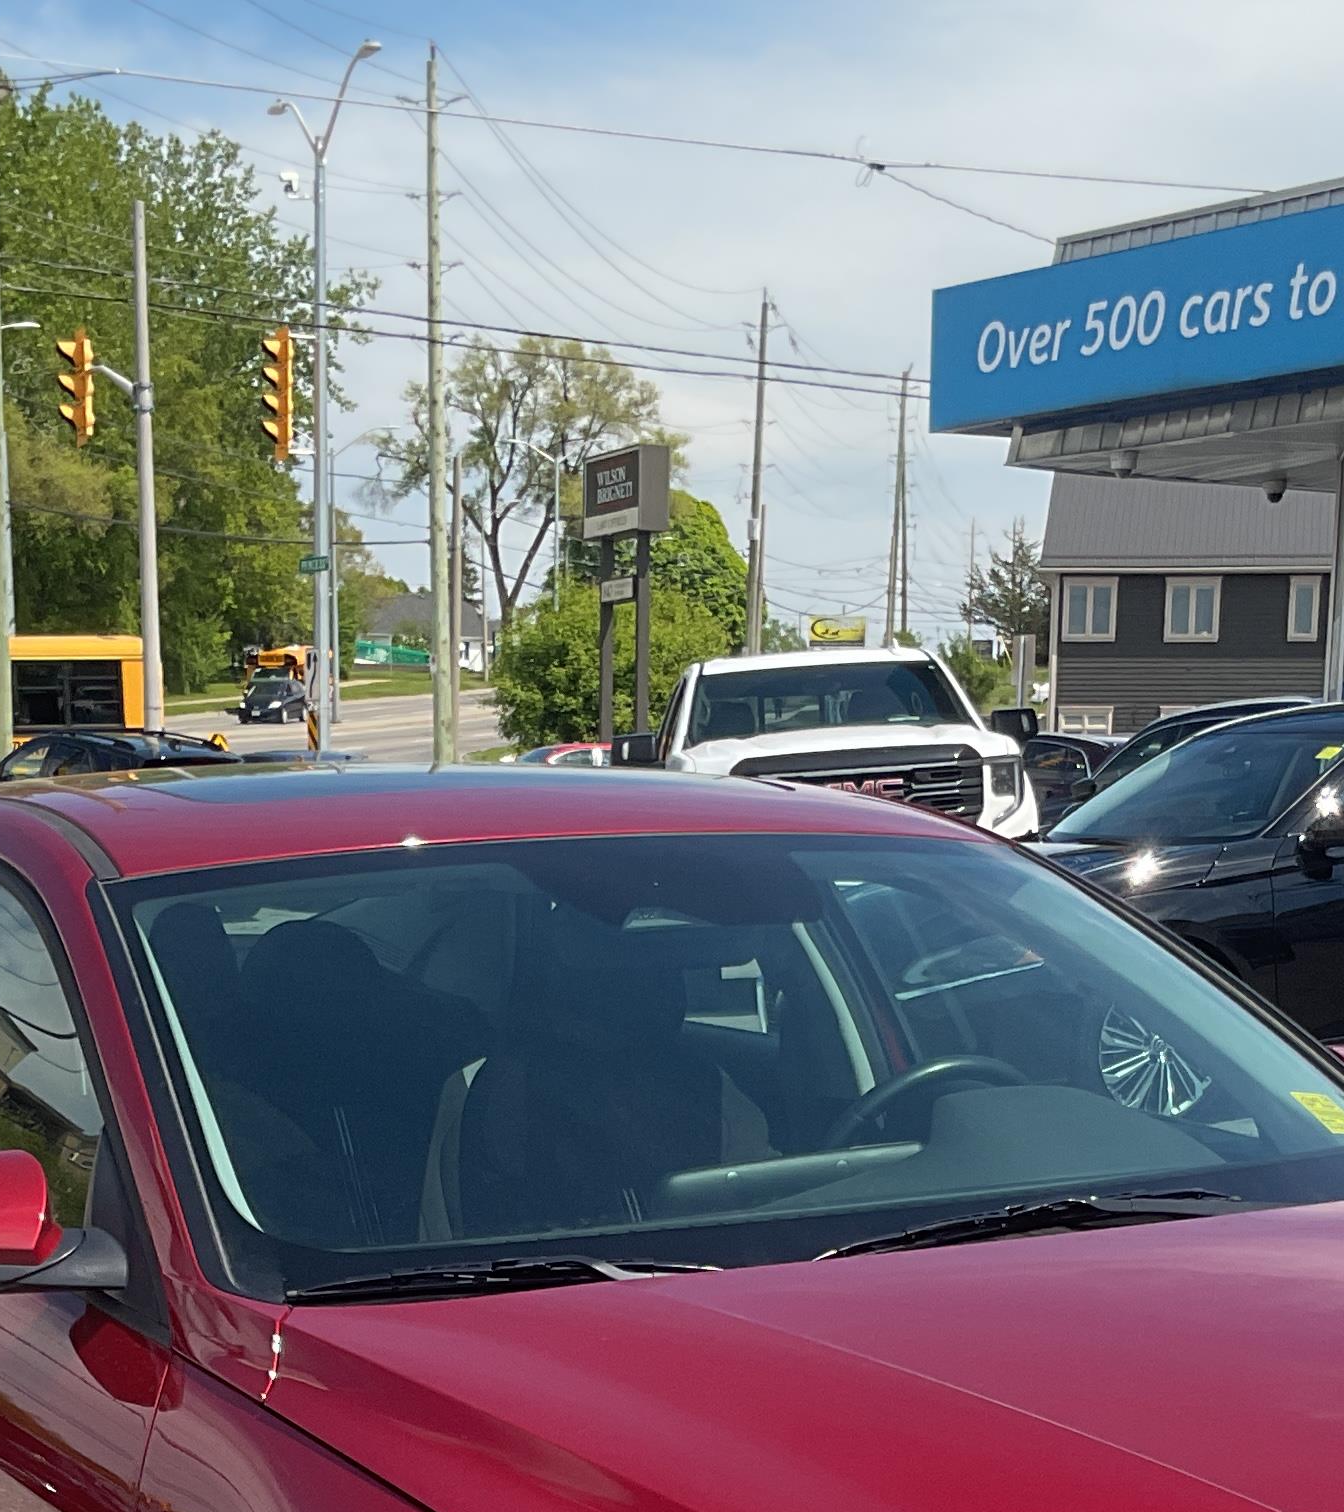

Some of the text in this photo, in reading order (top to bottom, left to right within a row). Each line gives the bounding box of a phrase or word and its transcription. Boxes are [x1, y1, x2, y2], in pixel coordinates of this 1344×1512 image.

[976, 318, 1073, 373] Over
[1079, 290, 1166, 357] 500
[1179, 281, 1274, 338] cars
[1289, 261, 1337, 320] to
[596, 465, 626, 486] WILSON
[826, 779, 905, 799] MC
